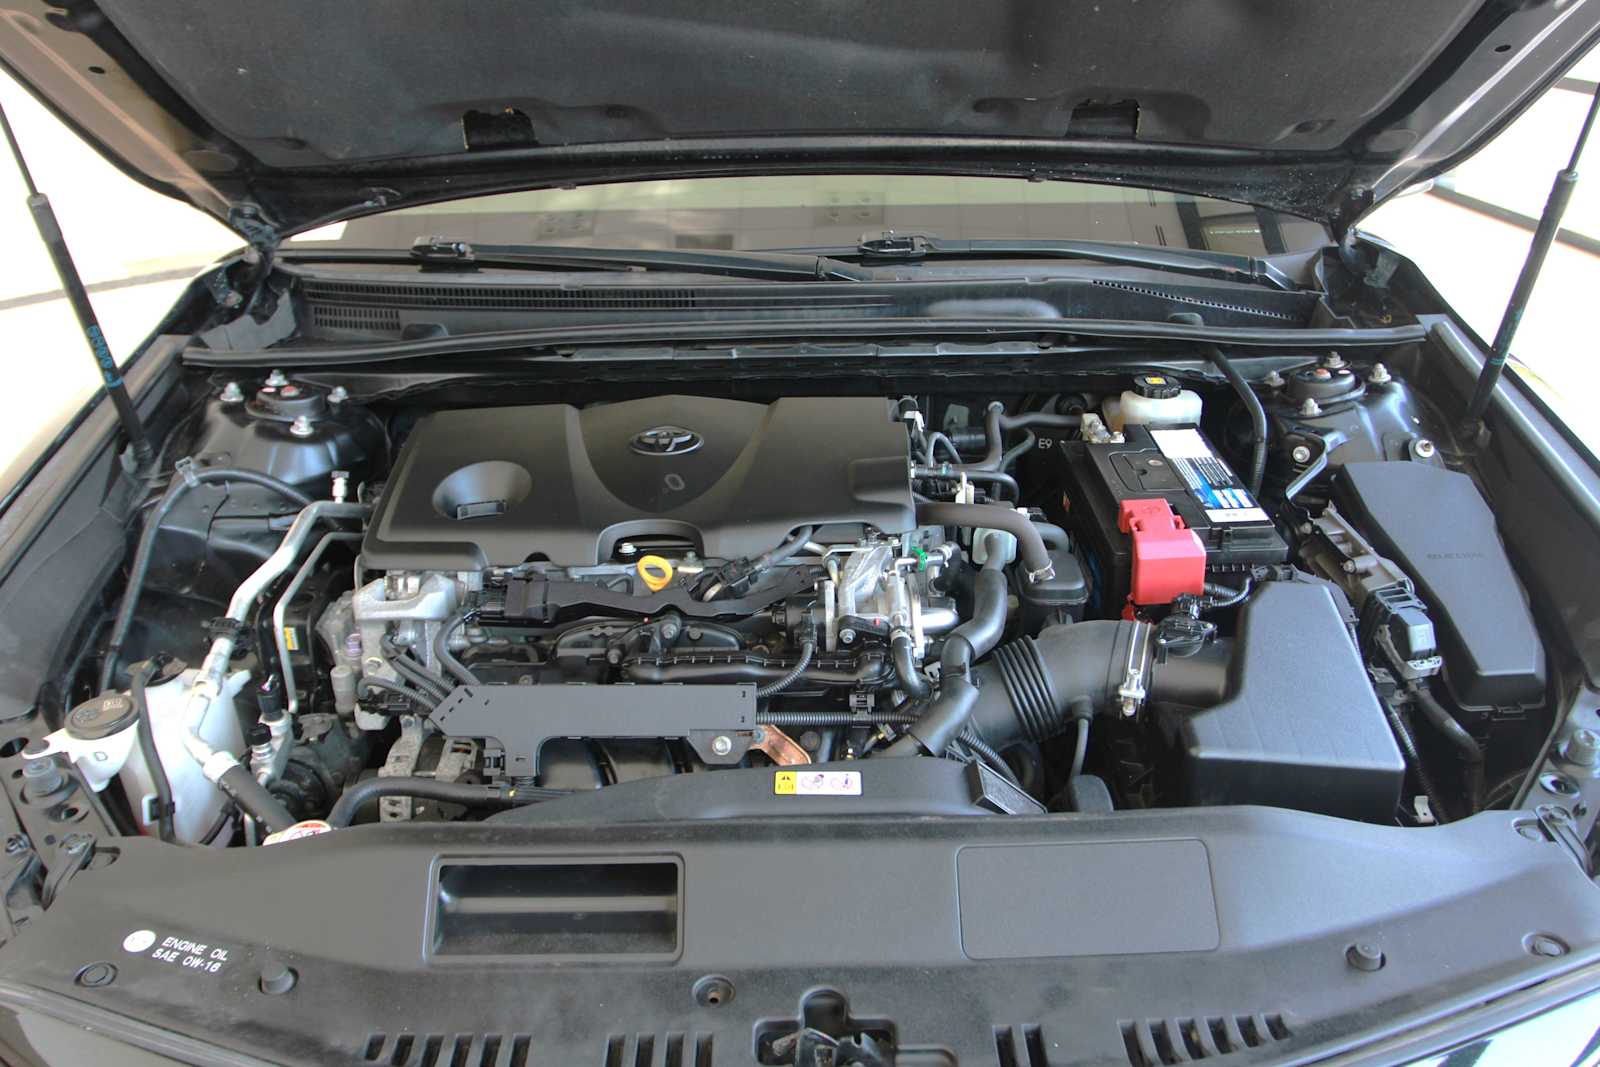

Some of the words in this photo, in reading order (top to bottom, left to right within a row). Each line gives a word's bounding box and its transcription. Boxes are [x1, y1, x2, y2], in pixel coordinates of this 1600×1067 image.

[1038, 438, 1053, 449] E9
[152, 949, 180, 962] SAE
[162, 937, 207, 955] ENGINE
[210, 948, 229, 961] OIL
